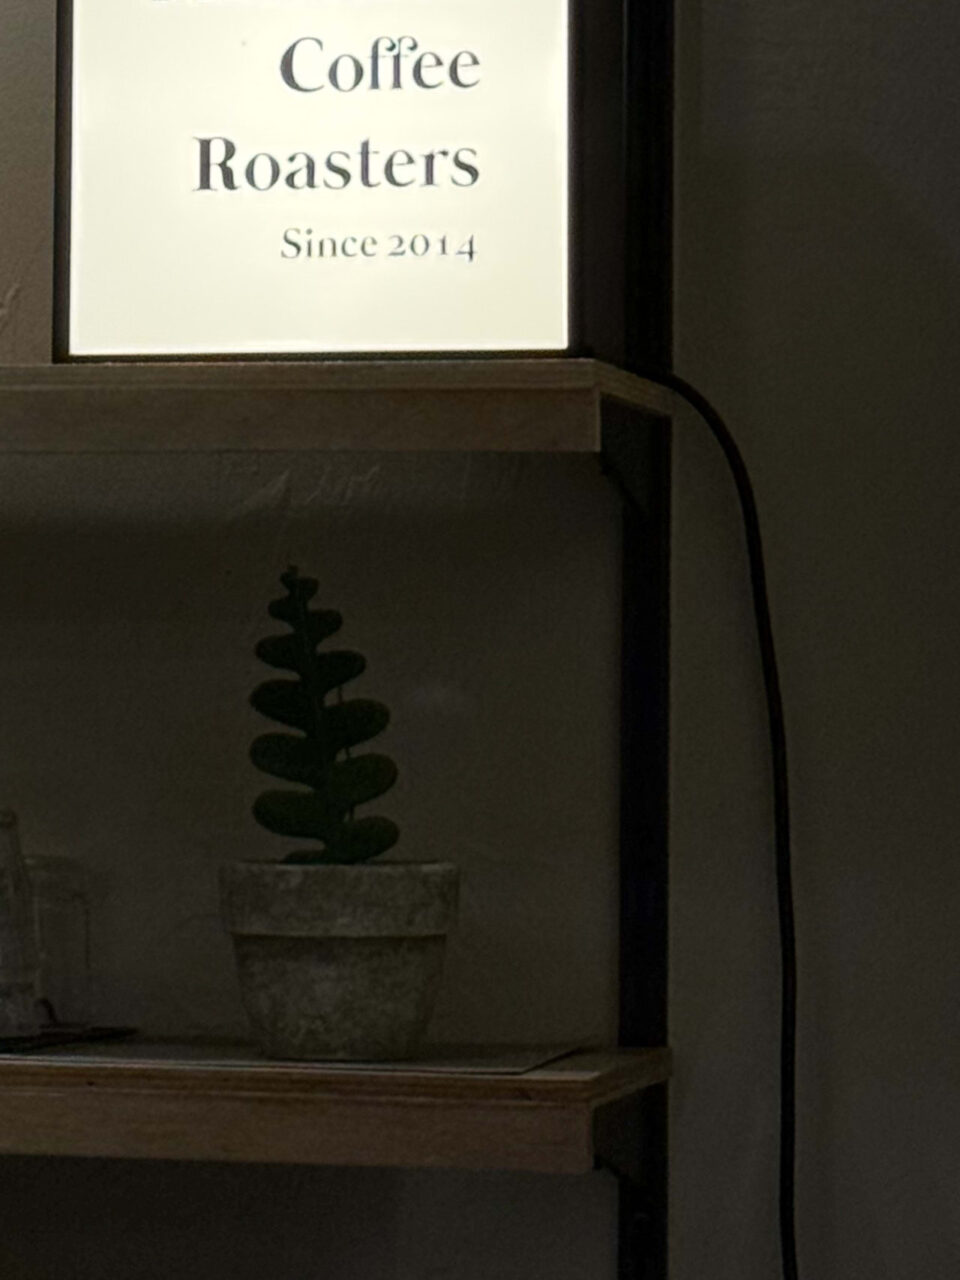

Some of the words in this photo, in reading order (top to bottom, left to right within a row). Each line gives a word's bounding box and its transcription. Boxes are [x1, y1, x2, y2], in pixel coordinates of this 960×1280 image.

[280, 36, 481, 93] Coffee
[193, 136, 480, 192] Roasters
[281, 228, 378, 260] Since
[387, 233, 477, 263] 2014
